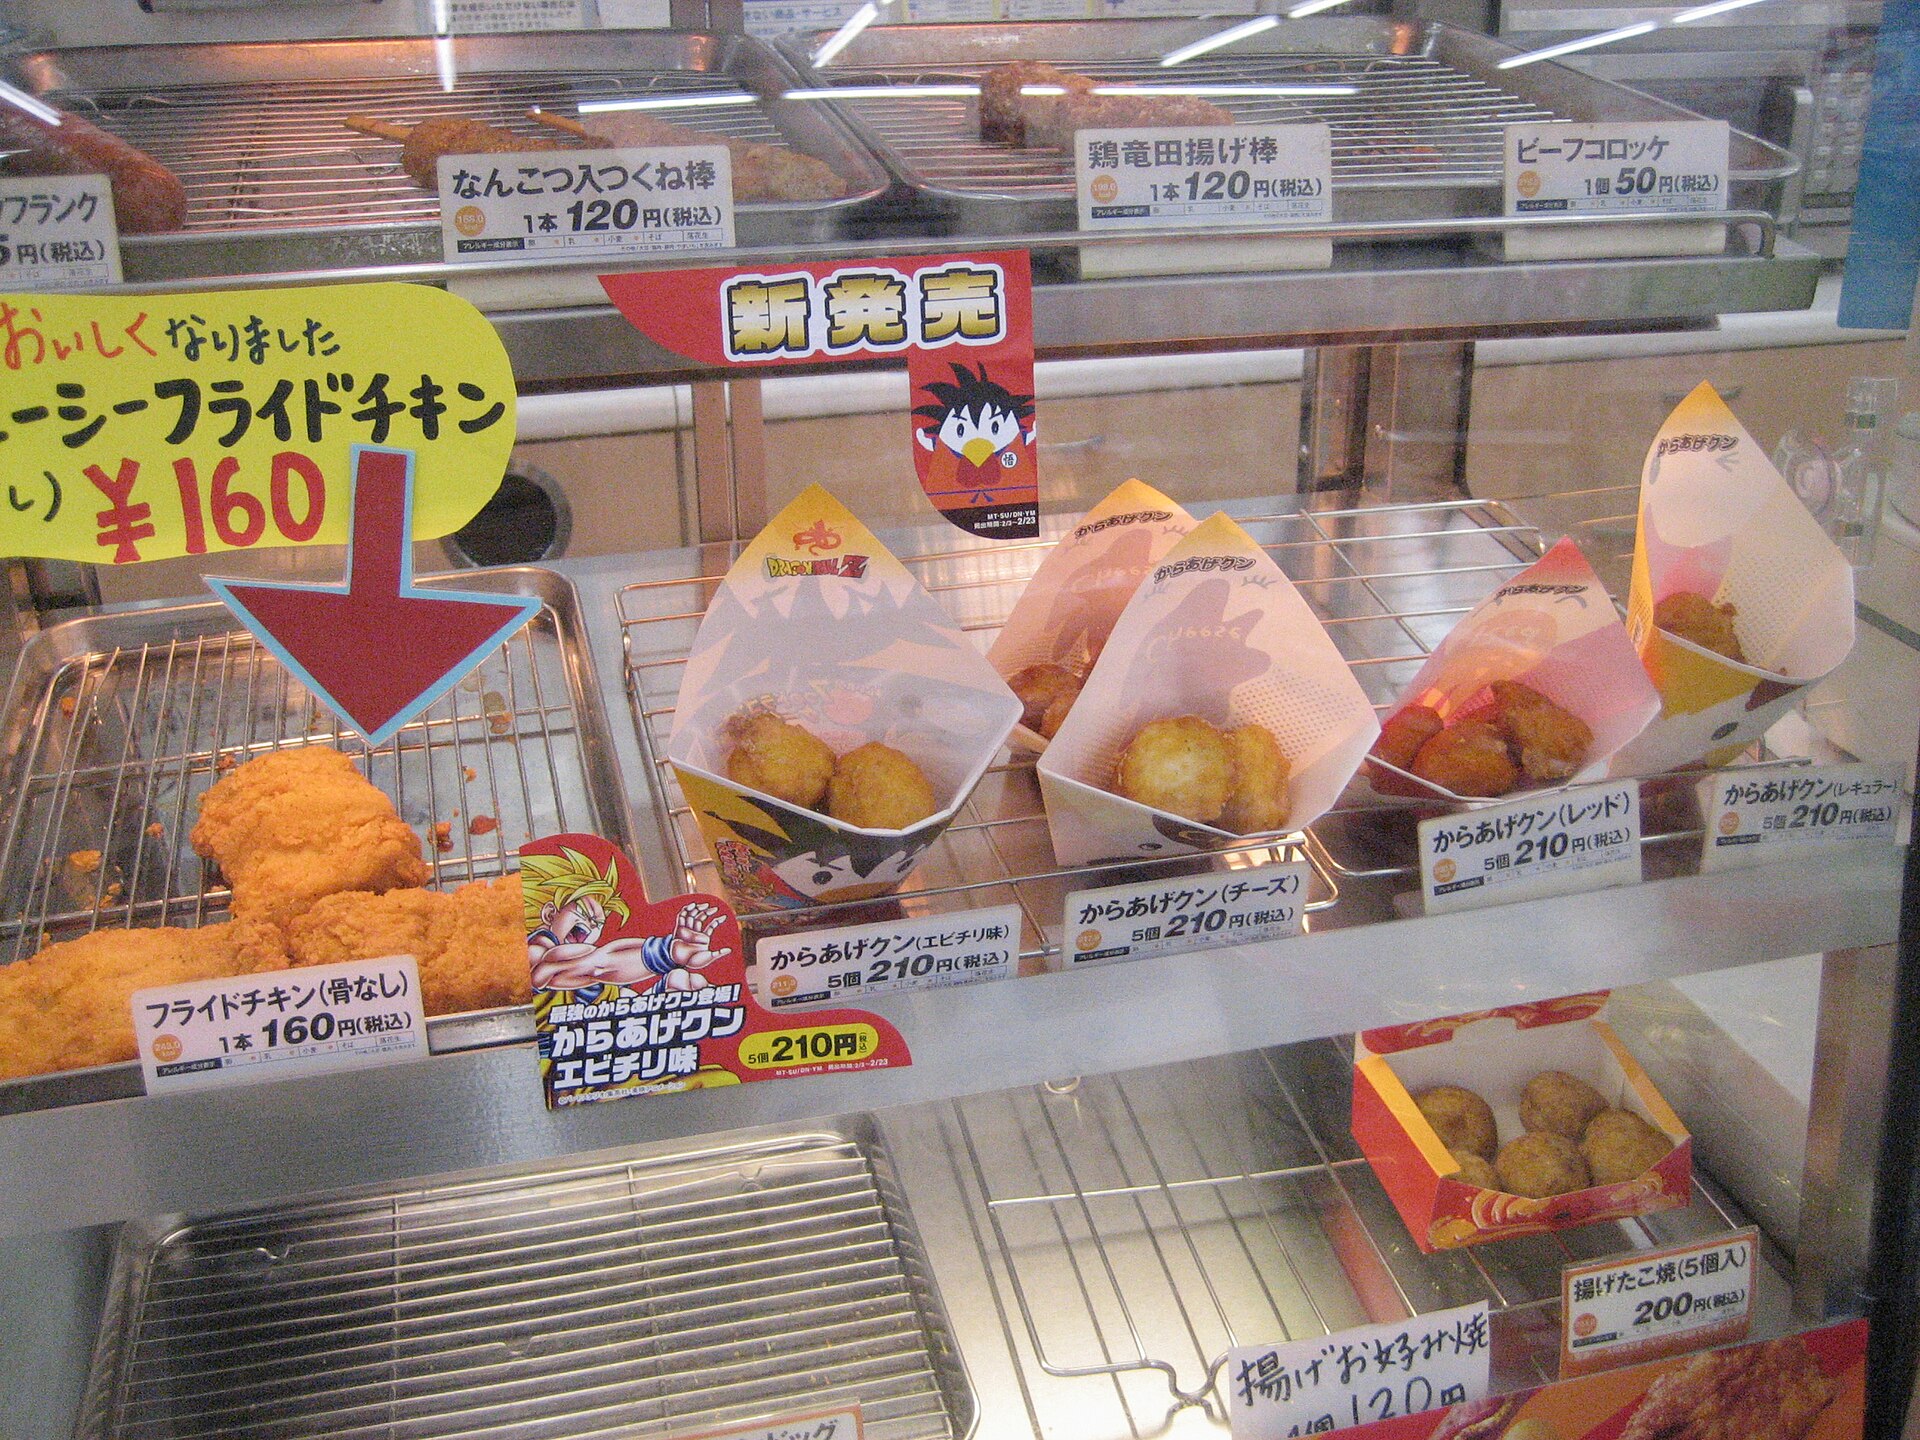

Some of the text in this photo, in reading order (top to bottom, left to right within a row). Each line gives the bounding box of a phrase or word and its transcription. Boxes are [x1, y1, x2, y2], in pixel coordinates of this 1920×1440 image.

[1088, 136, 1279, 169] 鶏竜田揚げ棒
[1517, 135, 1670, 164] ビーフコロッケ
[452, 160, 716, 200] なんこつ入つくね棒
[0, 191, 98, 226] フランク
[724, 265, 1003, 357] 新発売
[0, 372, 506, 448] ーシーフライドチキン
[1153, 556, 1257, 585] からあげクン
[1432, 791, 1630, 854] からあげクン(レッド)
[1079, 874, 1300, 925] からあげクン(チーズ)
[770, 924, 1010, 972] からあげクン(エビチリ味)
[145, 970, 408, 1029] フライドチキン(骨なし)
[551, 1006, 745, 1058] からあげクン
[553, 1045, 699, 1090] エビチリ味
[1573, 1245, 1747, 1303] 揚げたこ焼(5個入)
[1236, 1311, 1489, 1407] 揚げお好み焼
